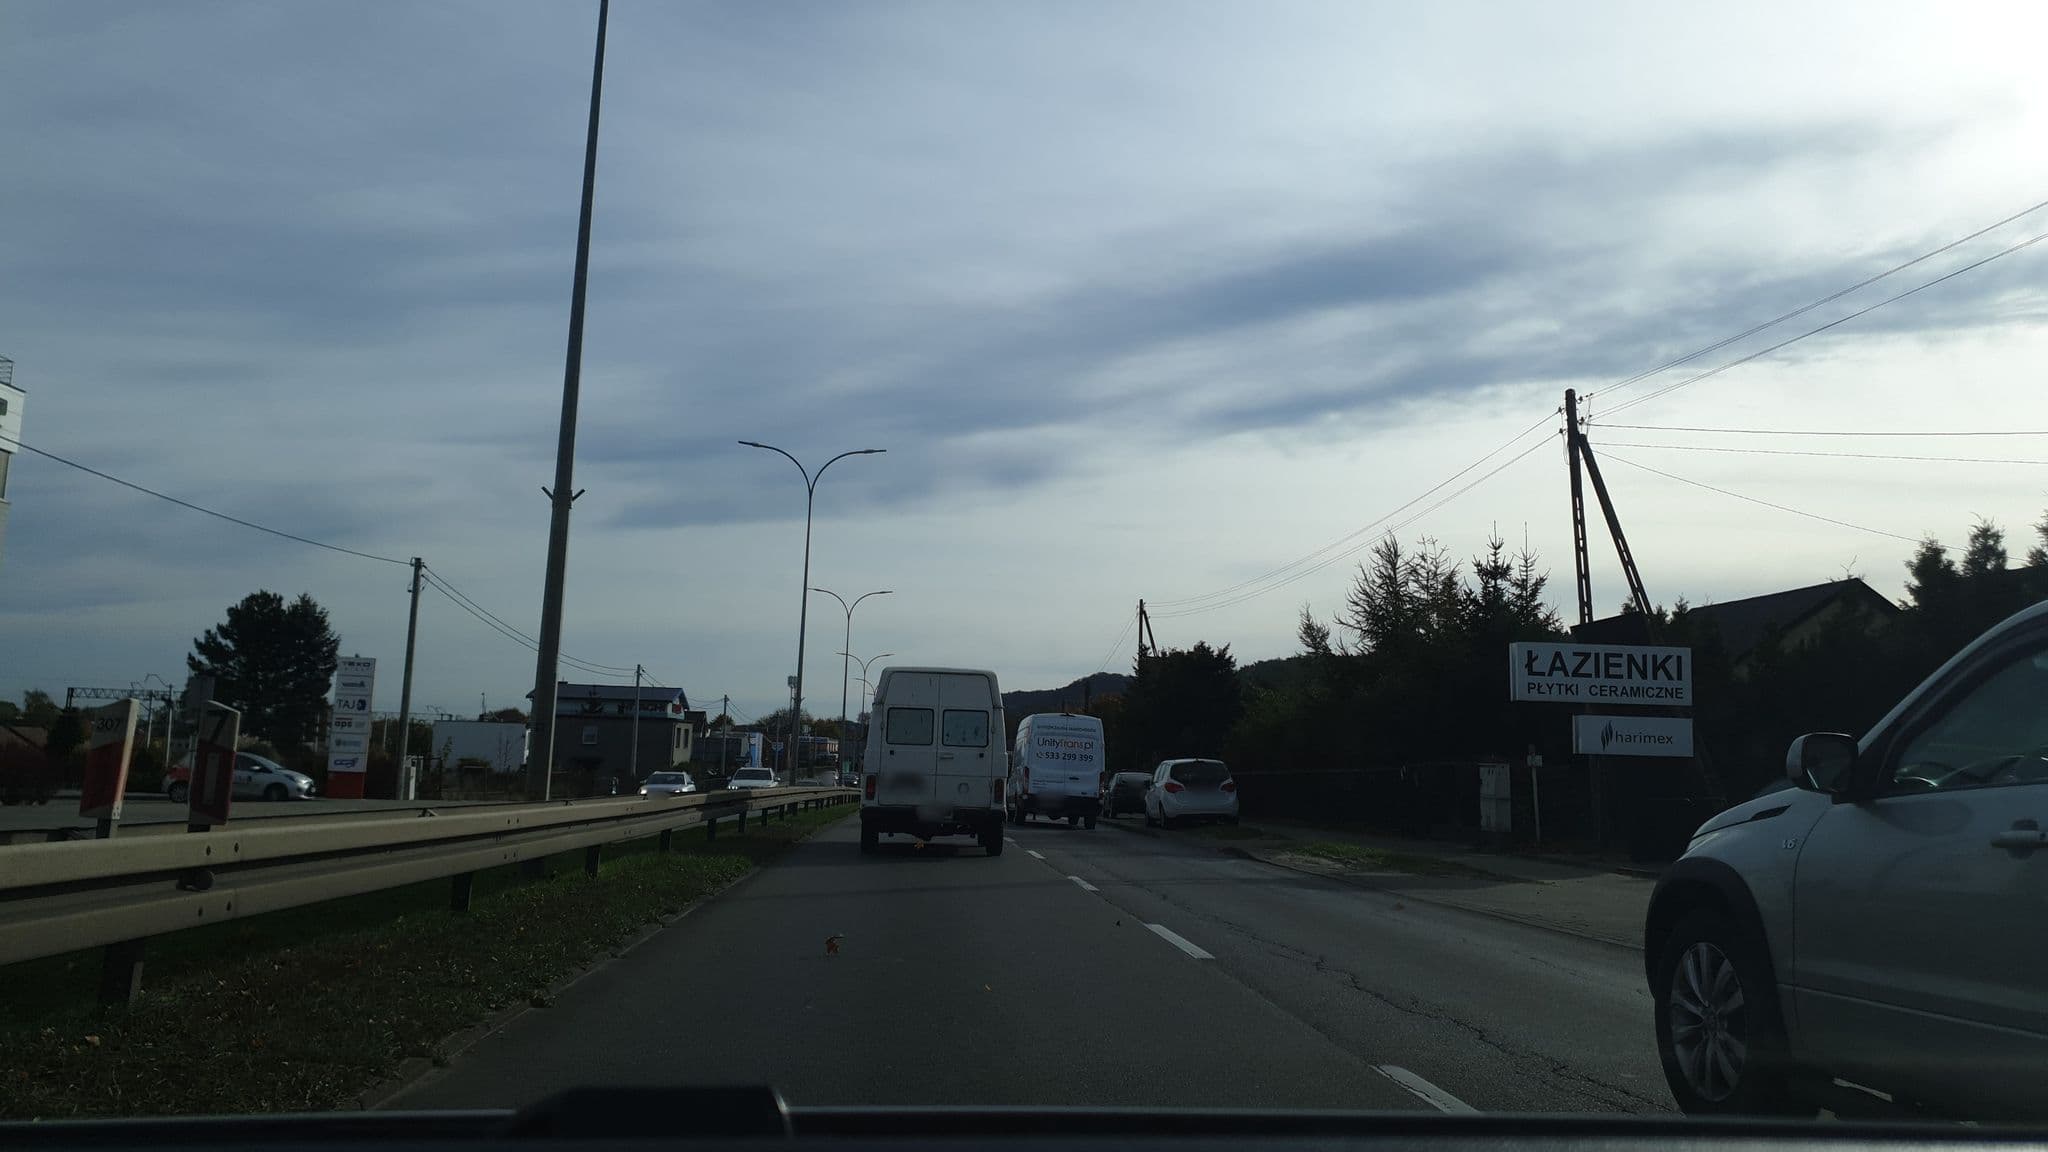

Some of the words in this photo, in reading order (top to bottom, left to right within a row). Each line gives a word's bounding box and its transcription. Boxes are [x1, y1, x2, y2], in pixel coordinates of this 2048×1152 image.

[1525, 649, 1683, 682] ŁAZIENKI
[1527, 682, 1579, 697] PŁYTKI
[1589, 684, 1684, 700] CERAMICZNE
[96, 717, 121, 731] 307
[1615, 730, 1674, 746] harimex
[1045, 752, 1060, 760] 533
[1062, 752, 1077, 762] 299
[1079, 753, 1094, 763] 399
